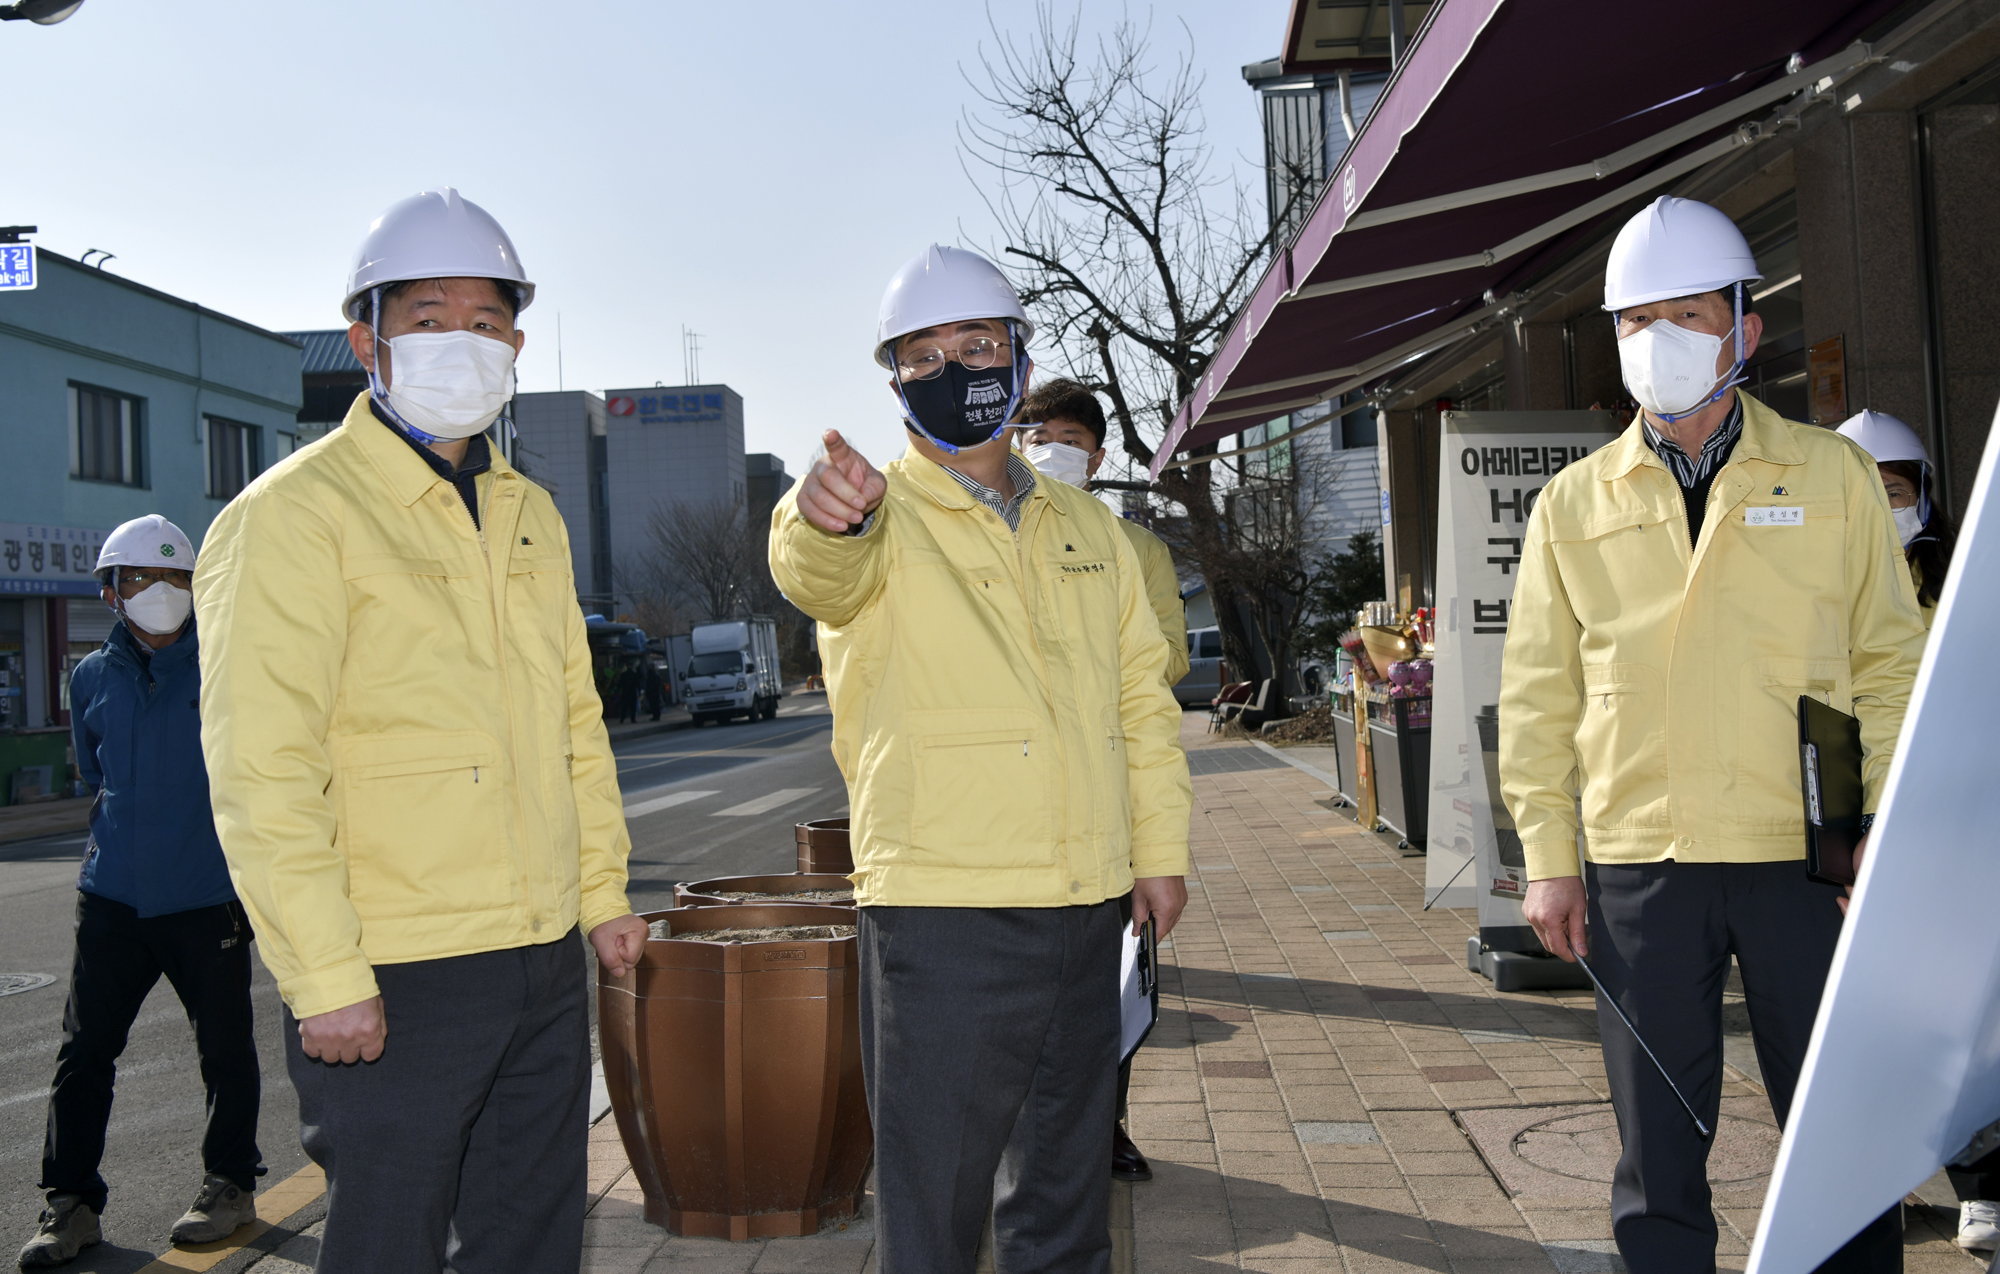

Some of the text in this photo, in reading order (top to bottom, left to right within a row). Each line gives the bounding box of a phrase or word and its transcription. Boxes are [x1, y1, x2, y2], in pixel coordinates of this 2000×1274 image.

[639, 393, 723, 415] 한국전력
[965, 408, 983, 423] 전북
[1461, 446, 1587, 476] 아메리카
[1487, 537, 1525, 575] 구
[1473, 599, 1512, 634] 브
